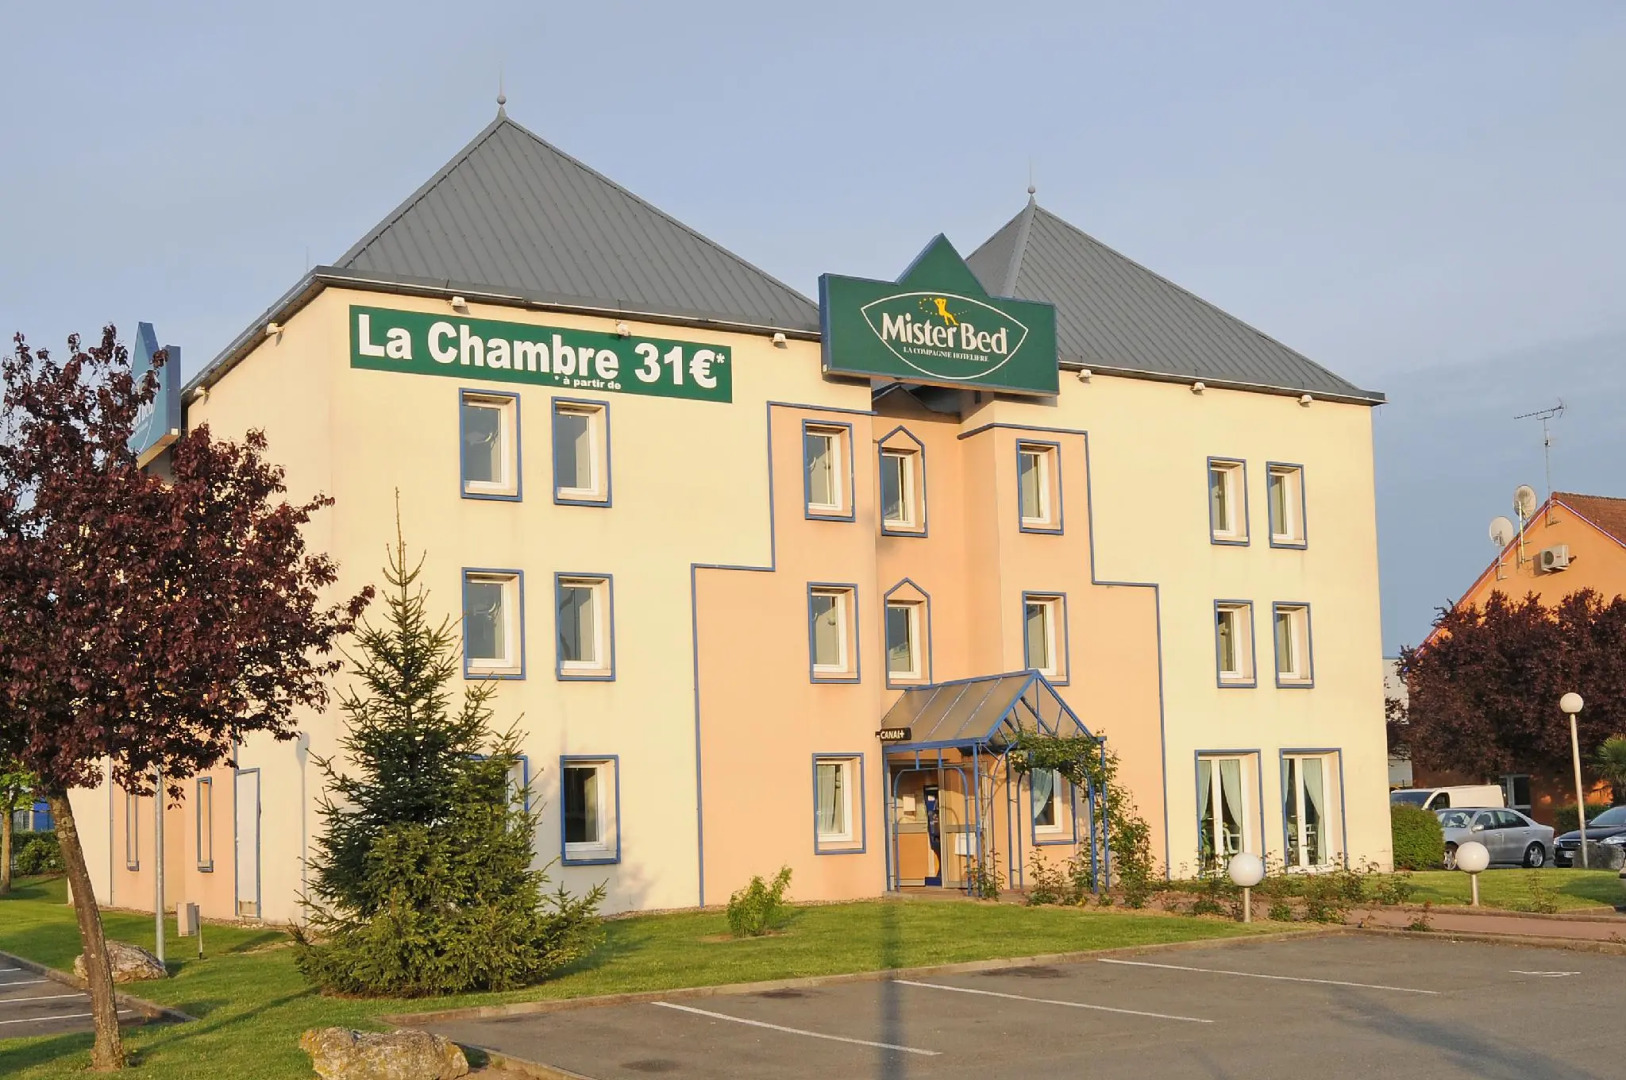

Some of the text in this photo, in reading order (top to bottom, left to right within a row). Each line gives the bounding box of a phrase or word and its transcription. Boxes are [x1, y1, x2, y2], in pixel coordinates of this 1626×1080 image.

[358, 313, 413, 360] La
[427, 321, 620, 380] Chambre
[882, 312, 1008, 355] Mister Bed
[903, 346, 913, 354] LA
[913, 347, 952, 358] COMPAGNIE
[563, 376, 570, 385] à
[573, 378, 605, 388] partir
[607, 380, 622, 390] de
